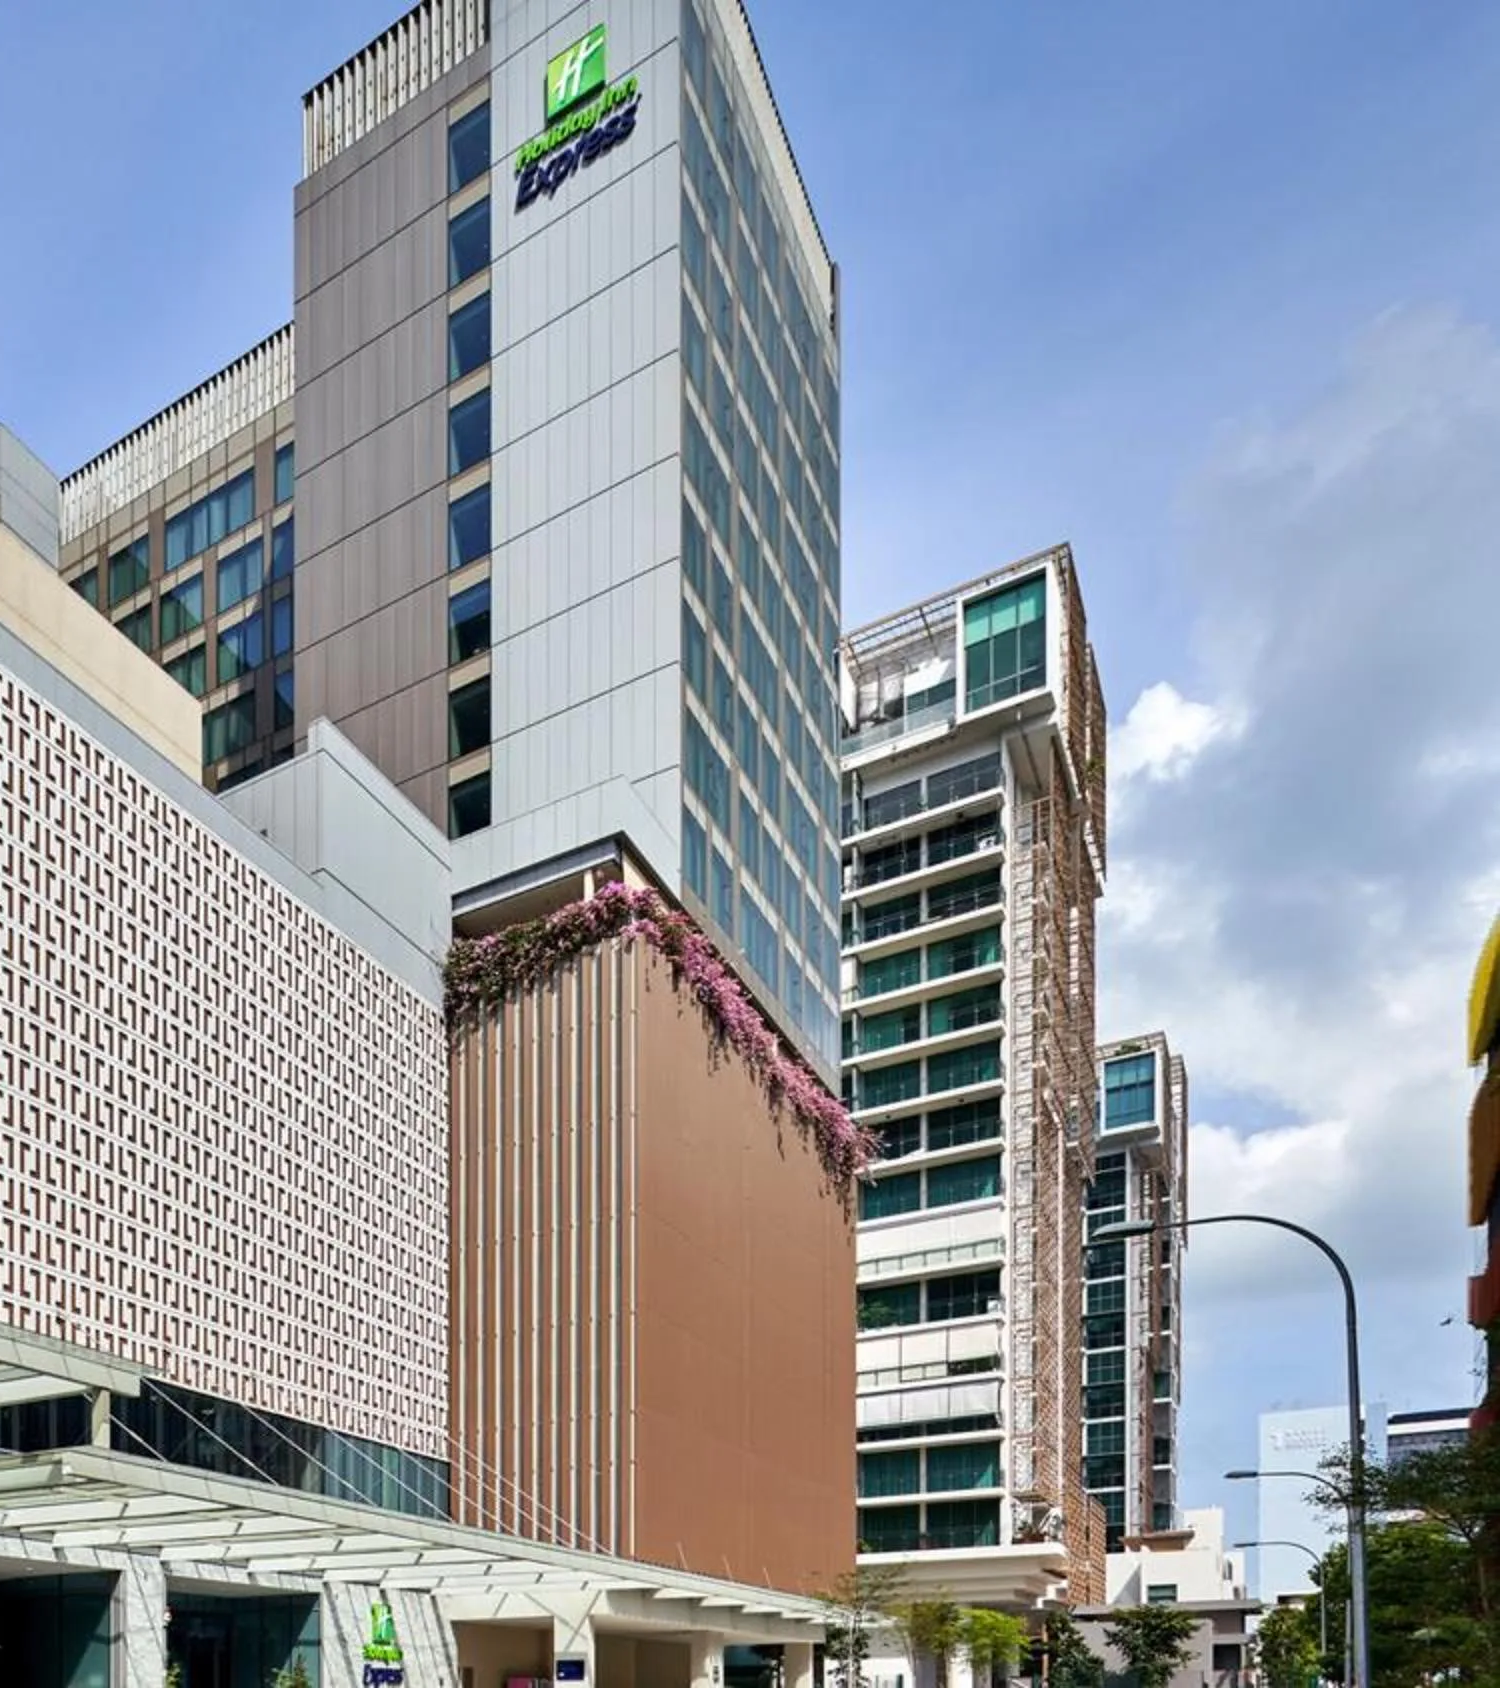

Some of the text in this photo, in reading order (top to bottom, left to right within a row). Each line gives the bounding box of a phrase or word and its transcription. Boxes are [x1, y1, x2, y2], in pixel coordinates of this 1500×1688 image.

[514, 75, 638, 176] Holiday Inn
[514, 94, 642, 215] Express
